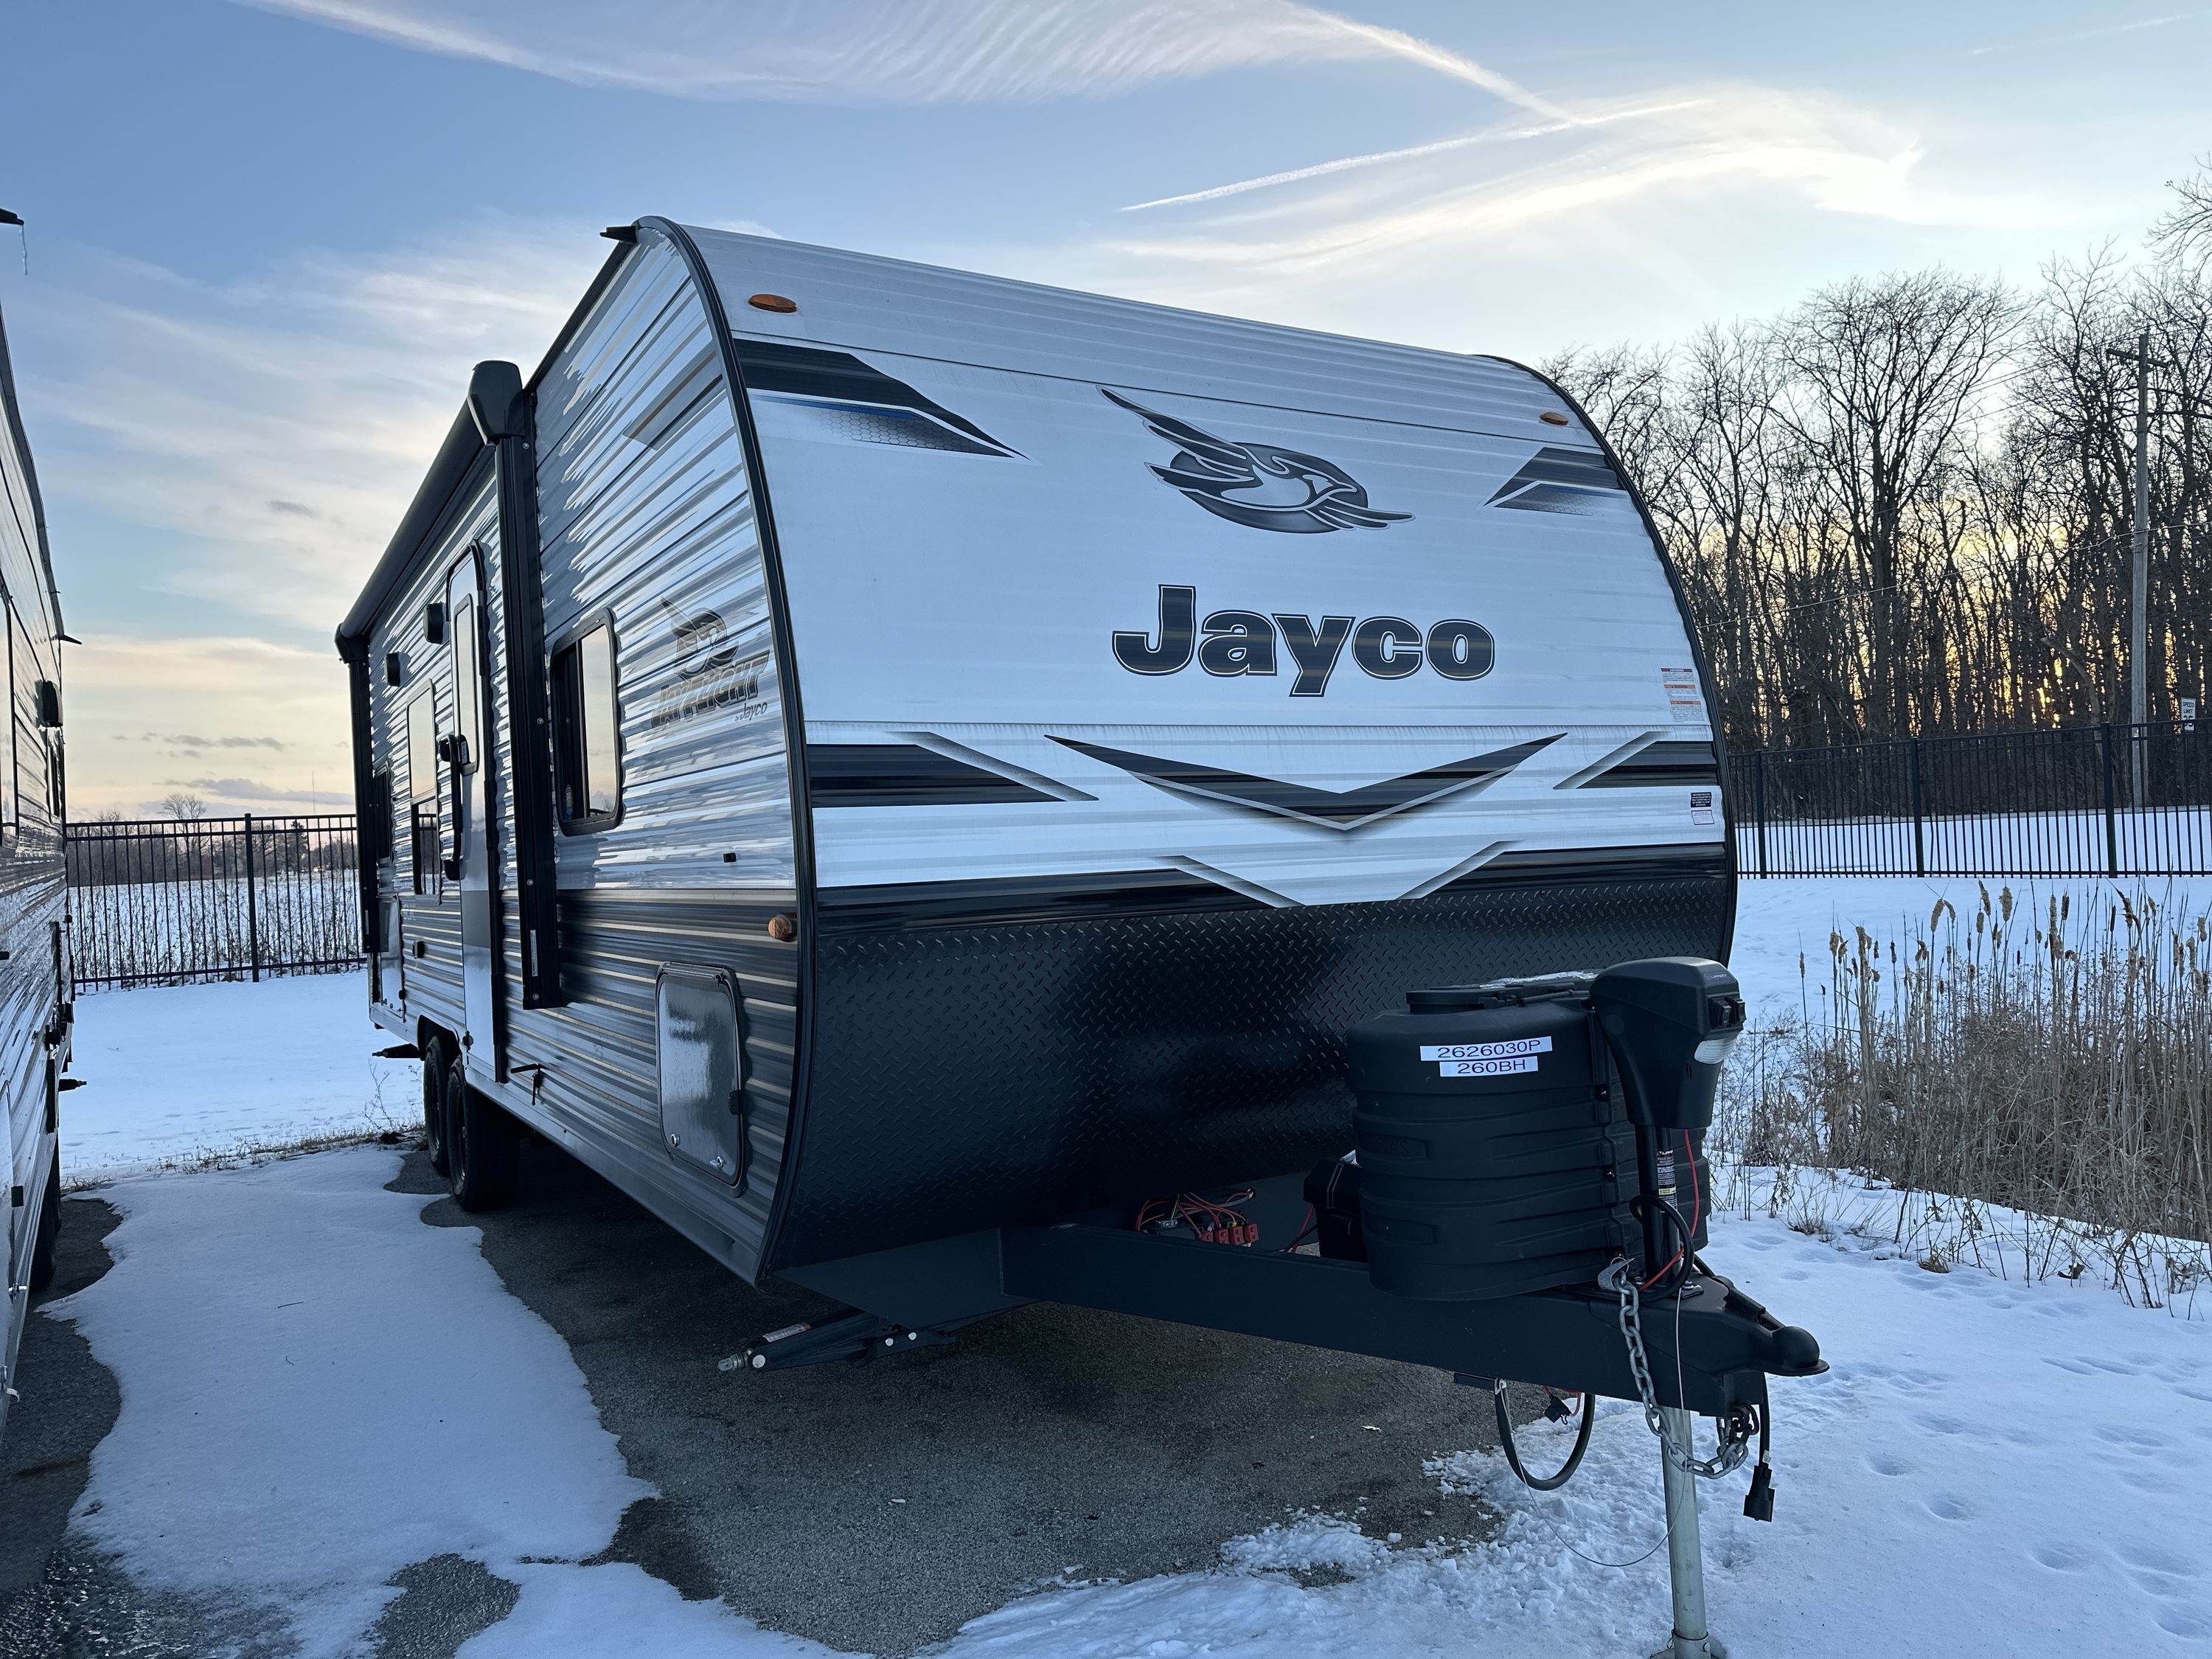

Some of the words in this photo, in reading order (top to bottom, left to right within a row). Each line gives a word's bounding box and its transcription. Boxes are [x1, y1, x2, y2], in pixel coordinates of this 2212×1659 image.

[1112, 584, 1495, 697] Jayco
[740, 702, 768, 721] Jayco
[1437, 1040, 1541, 1058] 2626030P
[1457, 1059, 1526, 1074] 260BH
